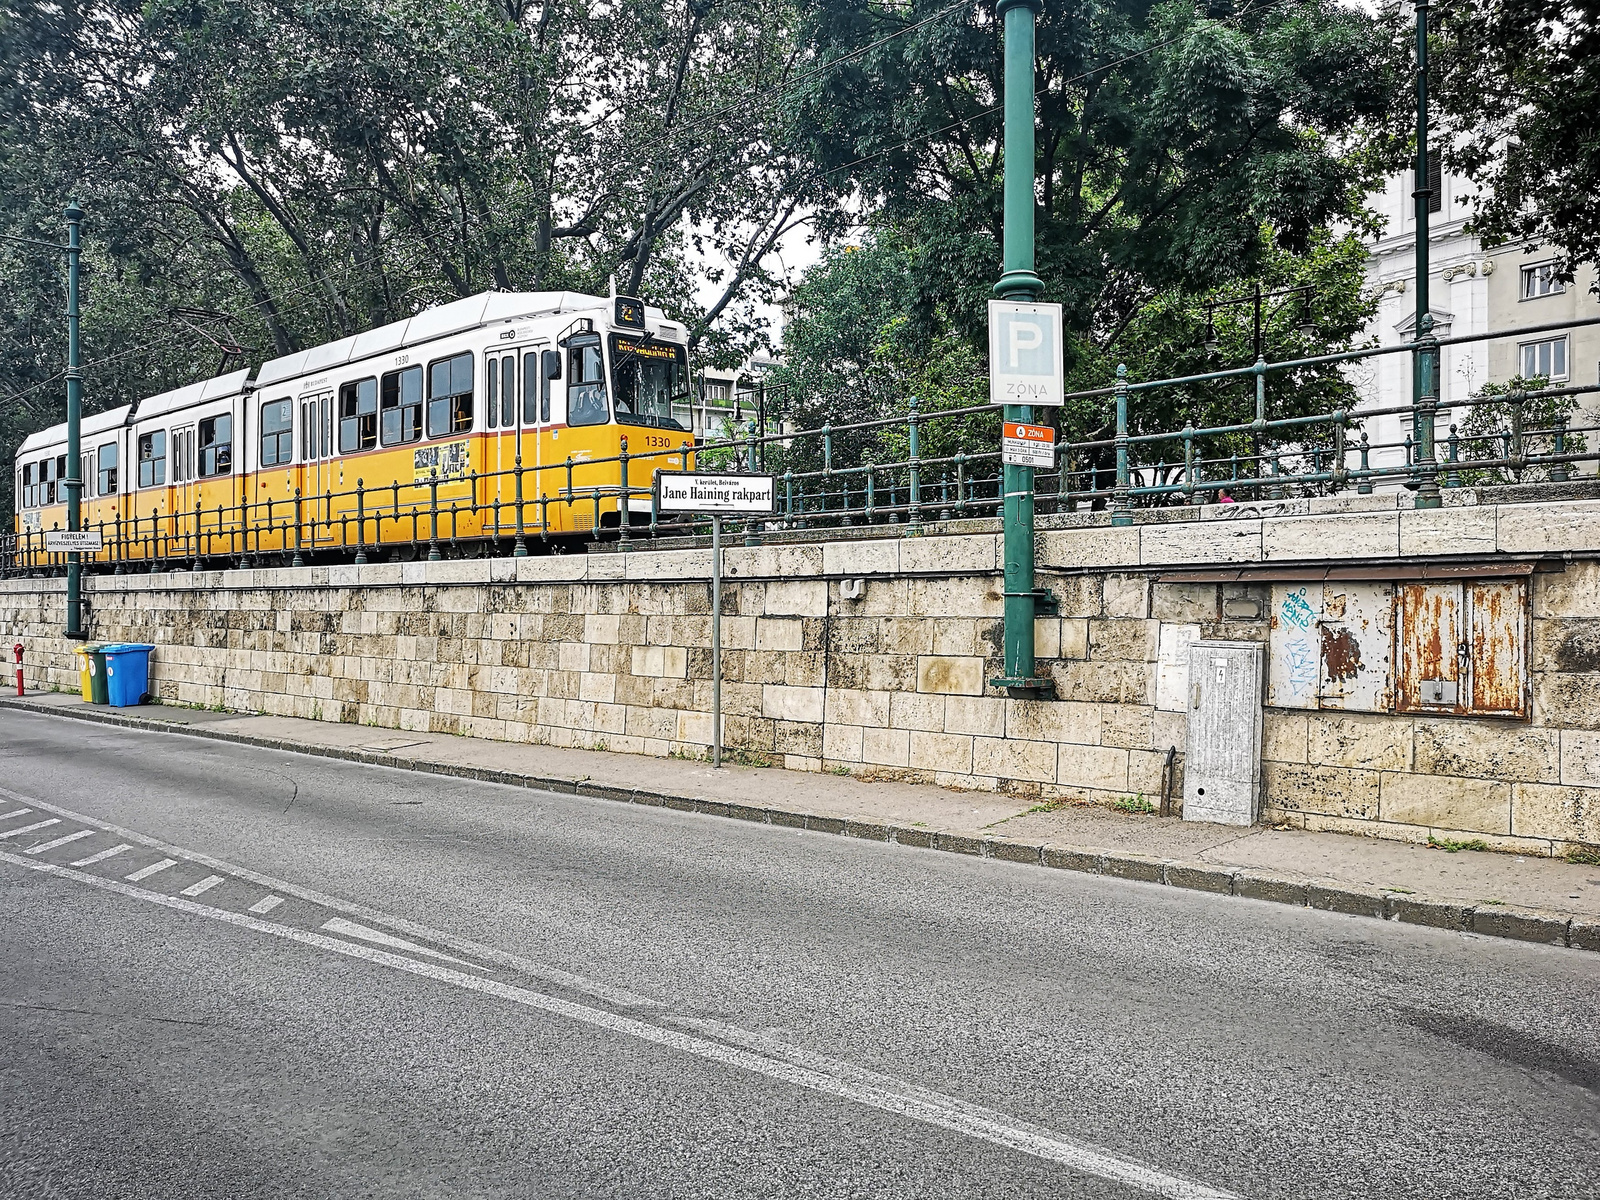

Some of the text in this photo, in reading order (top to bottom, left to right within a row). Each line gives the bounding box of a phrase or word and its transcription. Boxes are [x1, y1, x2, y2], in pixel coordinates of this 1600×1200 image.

[1009, 321, 1042, 367] P
[394, 354, 409, 366] 1330
[1006, 380, 1048, 395] ZÓNA
[1027, 428, 1044, 438] ZÓNA
[645, 435, 670, 448] 1330
[1021, 456, 1034, 464] 0501
[662, 486, 771, 503] Jane Haining rakpart
